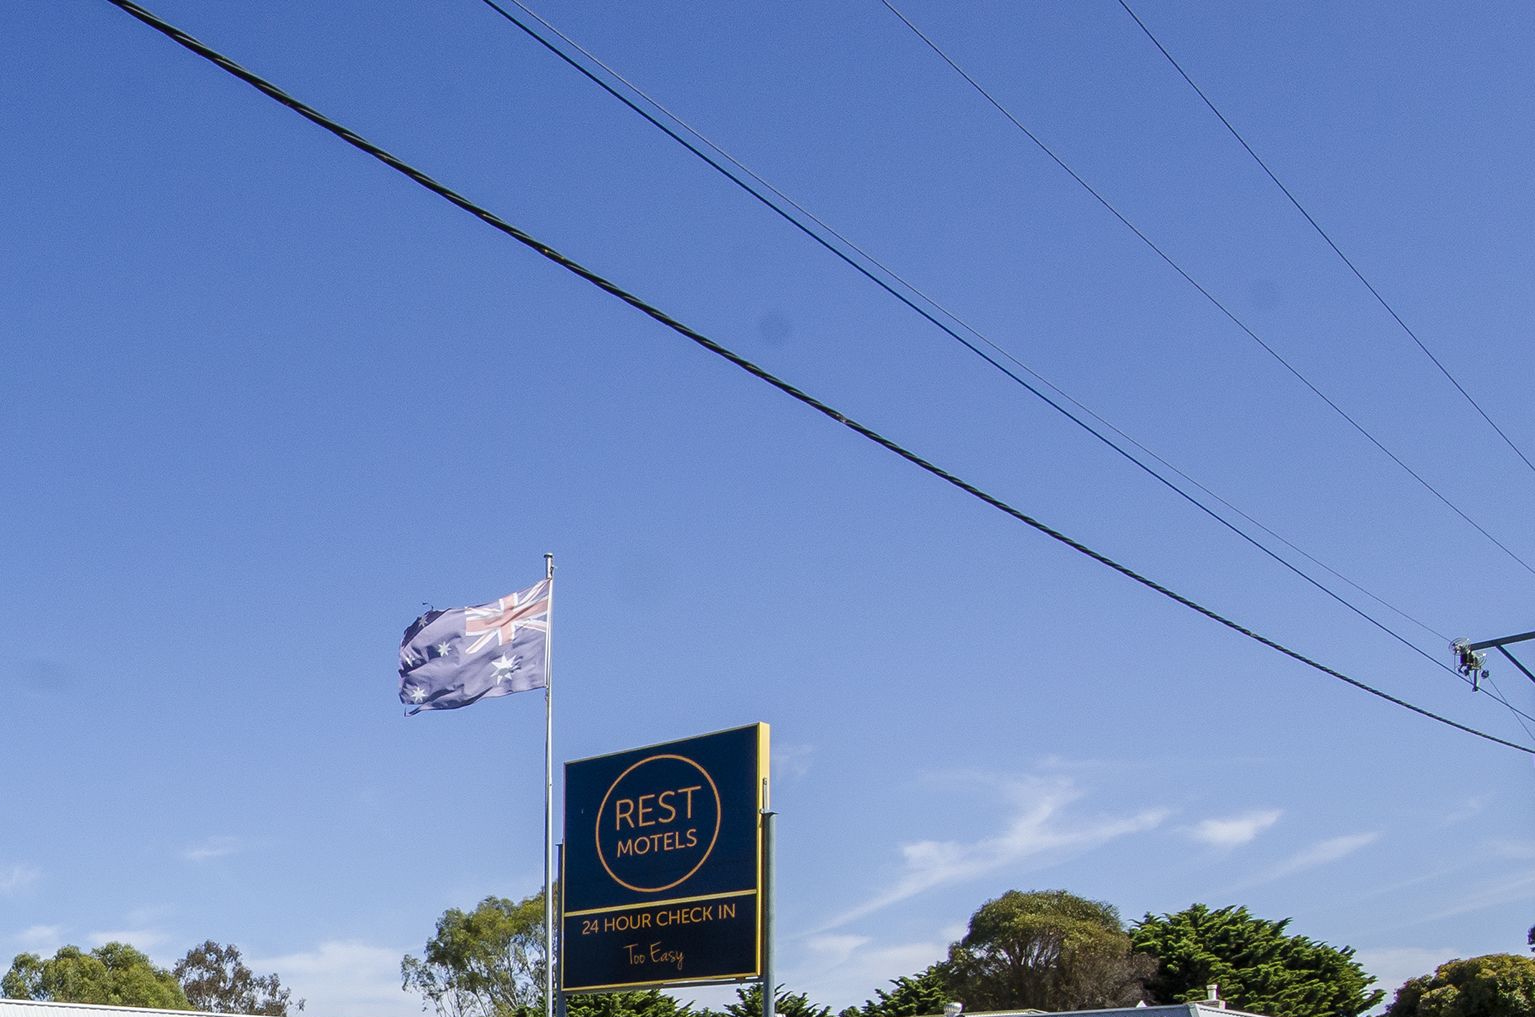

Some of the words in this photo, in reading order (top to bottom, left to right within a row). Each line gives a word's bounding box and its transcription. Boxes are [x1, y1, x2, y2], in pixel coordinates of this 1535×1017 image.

[616, 785, 701, 830] REST
[617, 828, 697, 858] MOTELS
[582, 920, 599, 935] 24
[604, 913, 652, 932] HOUR
[656, 906, 713, 926] CHECK
[718, 903, 736, 919] IN
[623, 943, 646, 965] Too
[650, 941, 685, 970] Easy
